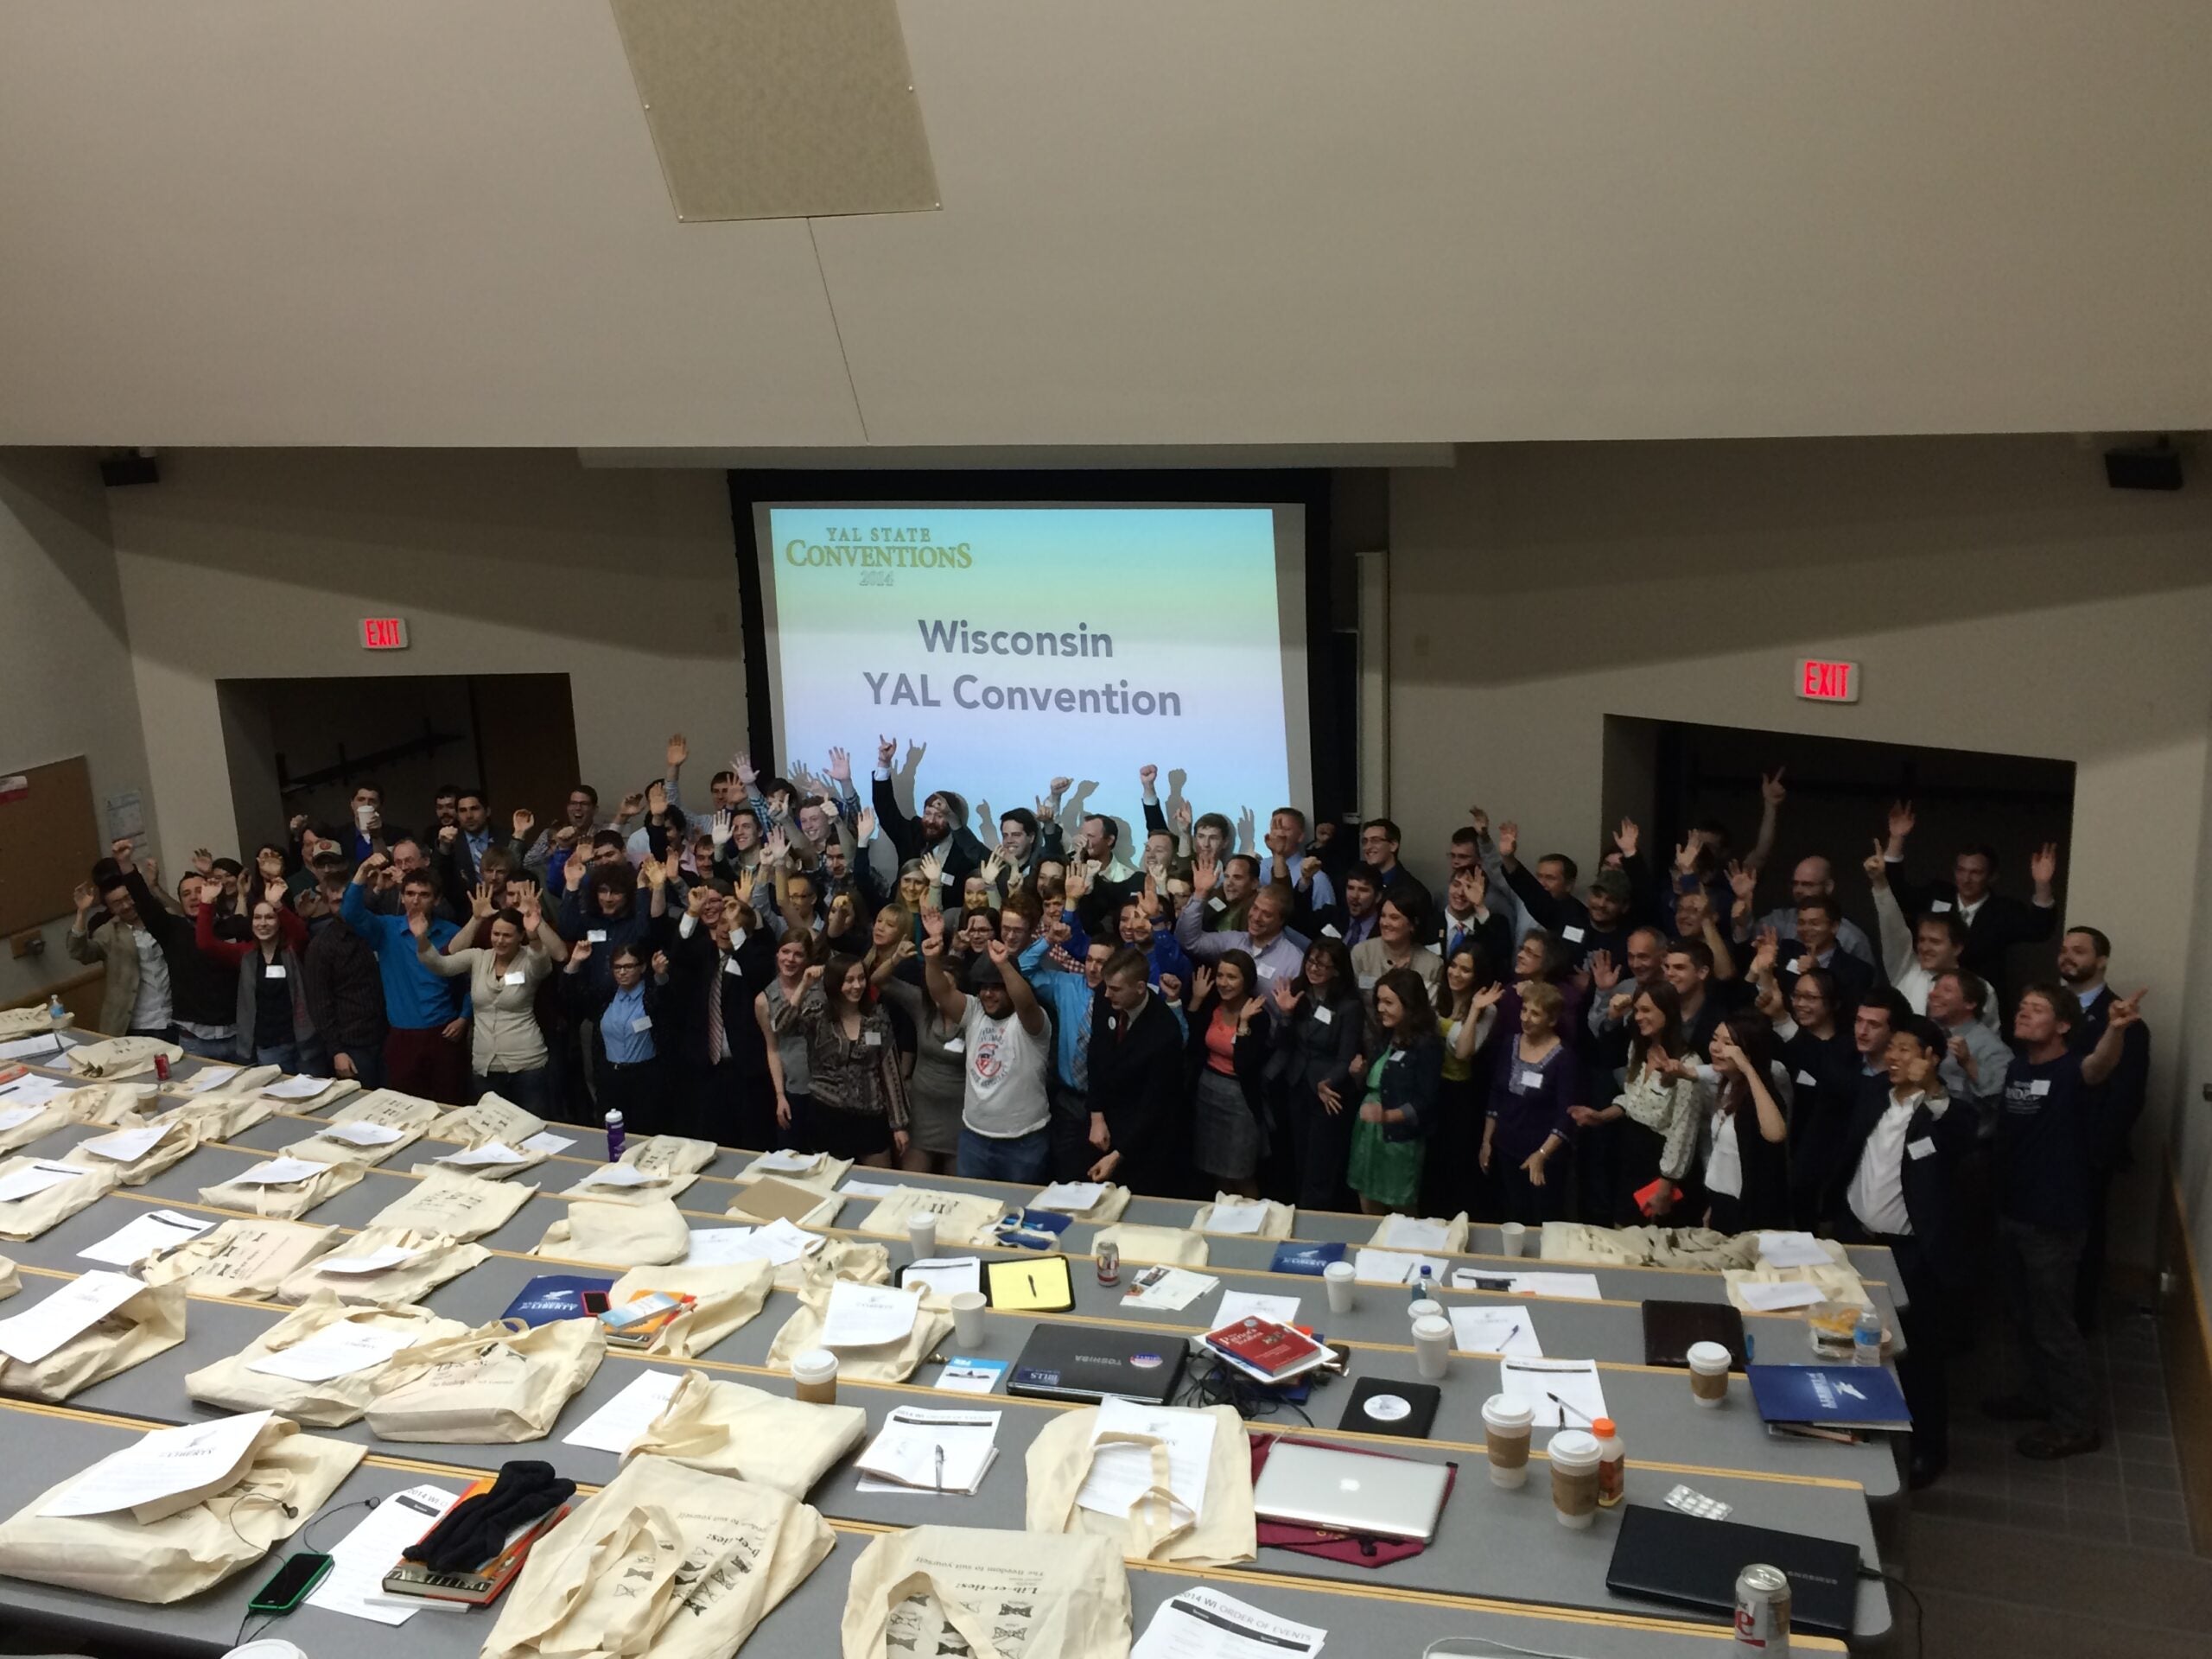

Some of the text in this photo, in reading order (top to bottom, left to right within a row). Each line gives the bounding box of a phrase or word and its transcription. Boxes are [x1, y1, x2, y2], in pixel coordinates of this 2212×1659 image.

[826, 527, 931, 543] YAL STATE
[785, 539, 973, 569] CONVENTIONS
[365, 620, 400, 646] EXIT
[918, 619, 1114, 658] Wisconsin
[1804, 662, 1850, 698] EXIT
[862, 671, 1182, 716] YAL Convention
[531, 1302, 578, 1311] LIBERTY
[1075, 1354, 1122, 1366] TOSHIBA
[916, 1555, 953, 1568] yourself
[988, 1566, 1024, 1575] freedom
[1204, 1598, 1217, 1609] WI
[1219, 1605, 1255, 1624] ORDER
[1255, 1620, 1268, 1630] OF
